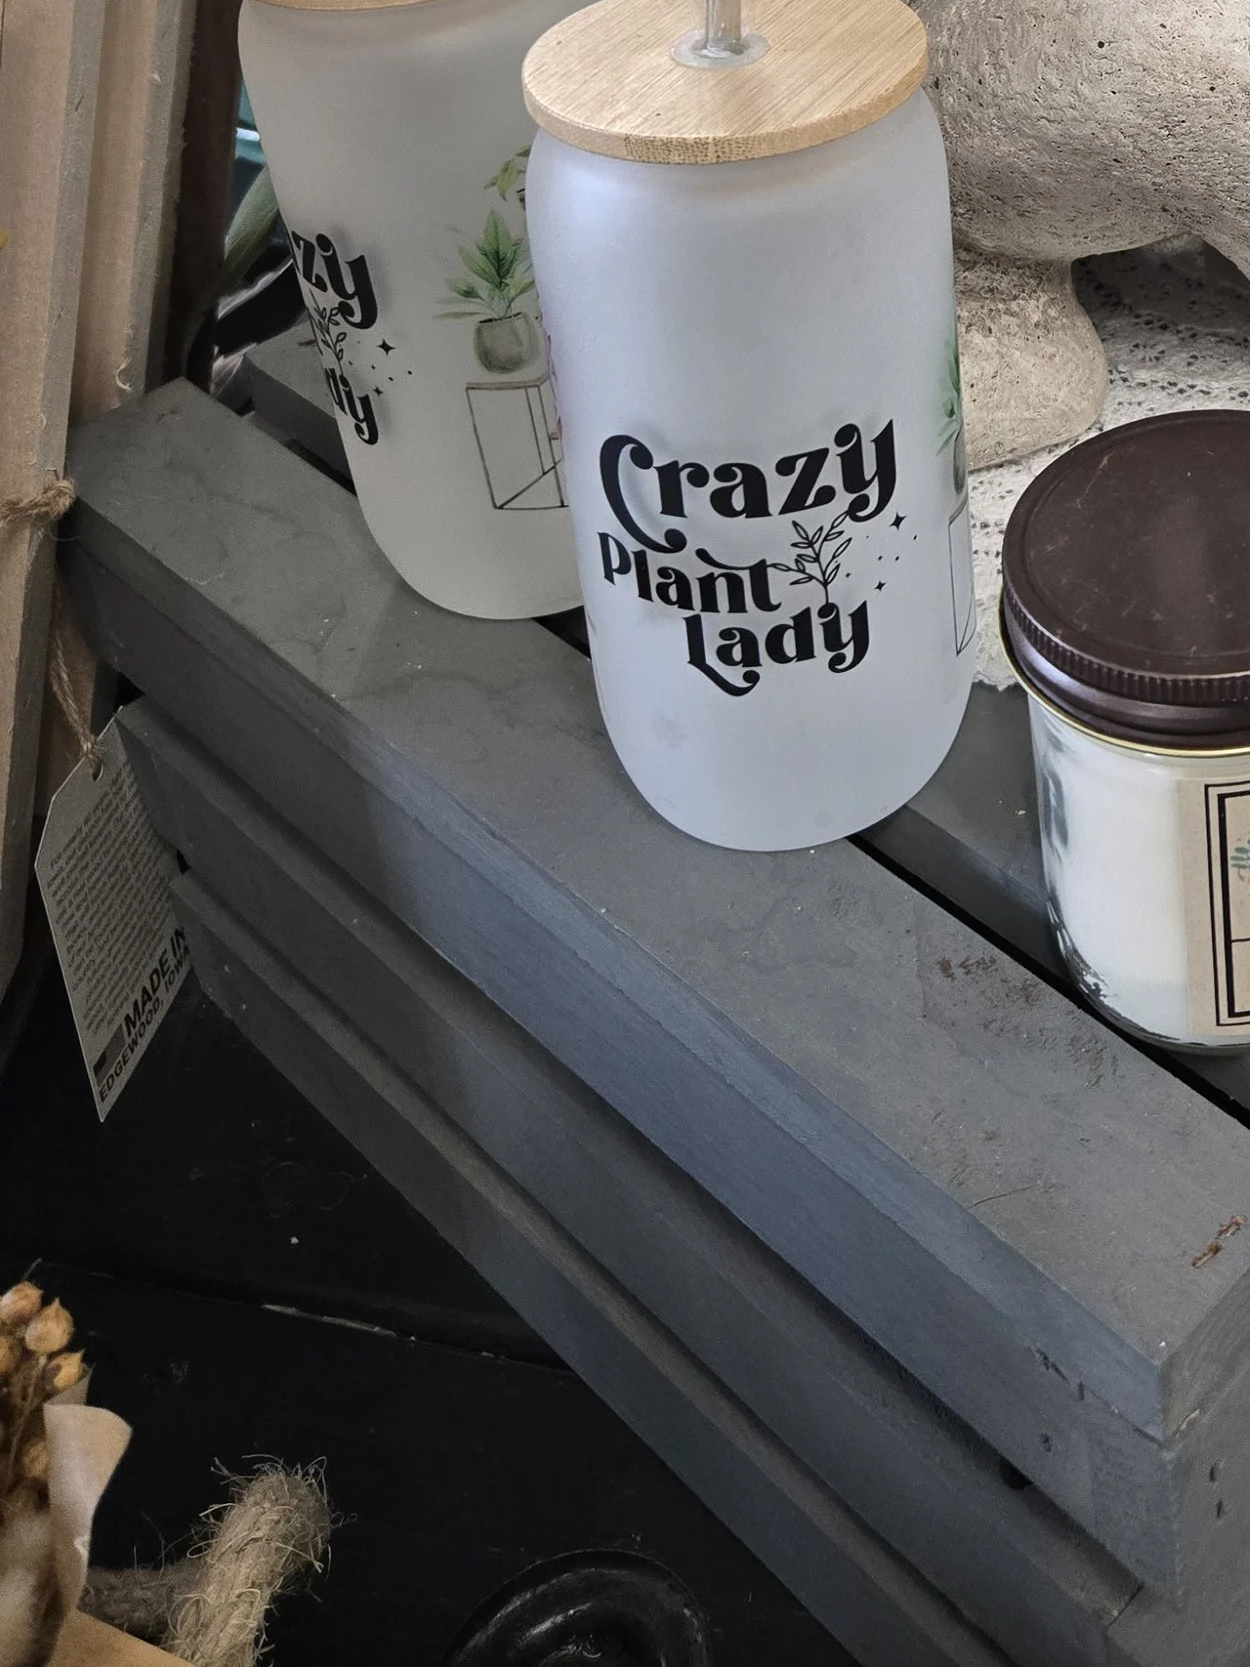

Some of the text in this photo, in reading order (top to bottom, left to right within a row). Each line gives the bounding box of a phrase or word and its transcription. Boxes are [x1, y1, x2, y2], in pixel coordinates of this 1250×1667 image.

[599, 419, 897, 554] Crazy
[597, 531, 783, 613] Plant
[682, 600, 870, 697] Lady
[99, 945, 190, 1103] EDGEWOOD, IOWA
[123, 926, 187, 1038] MADE IN
